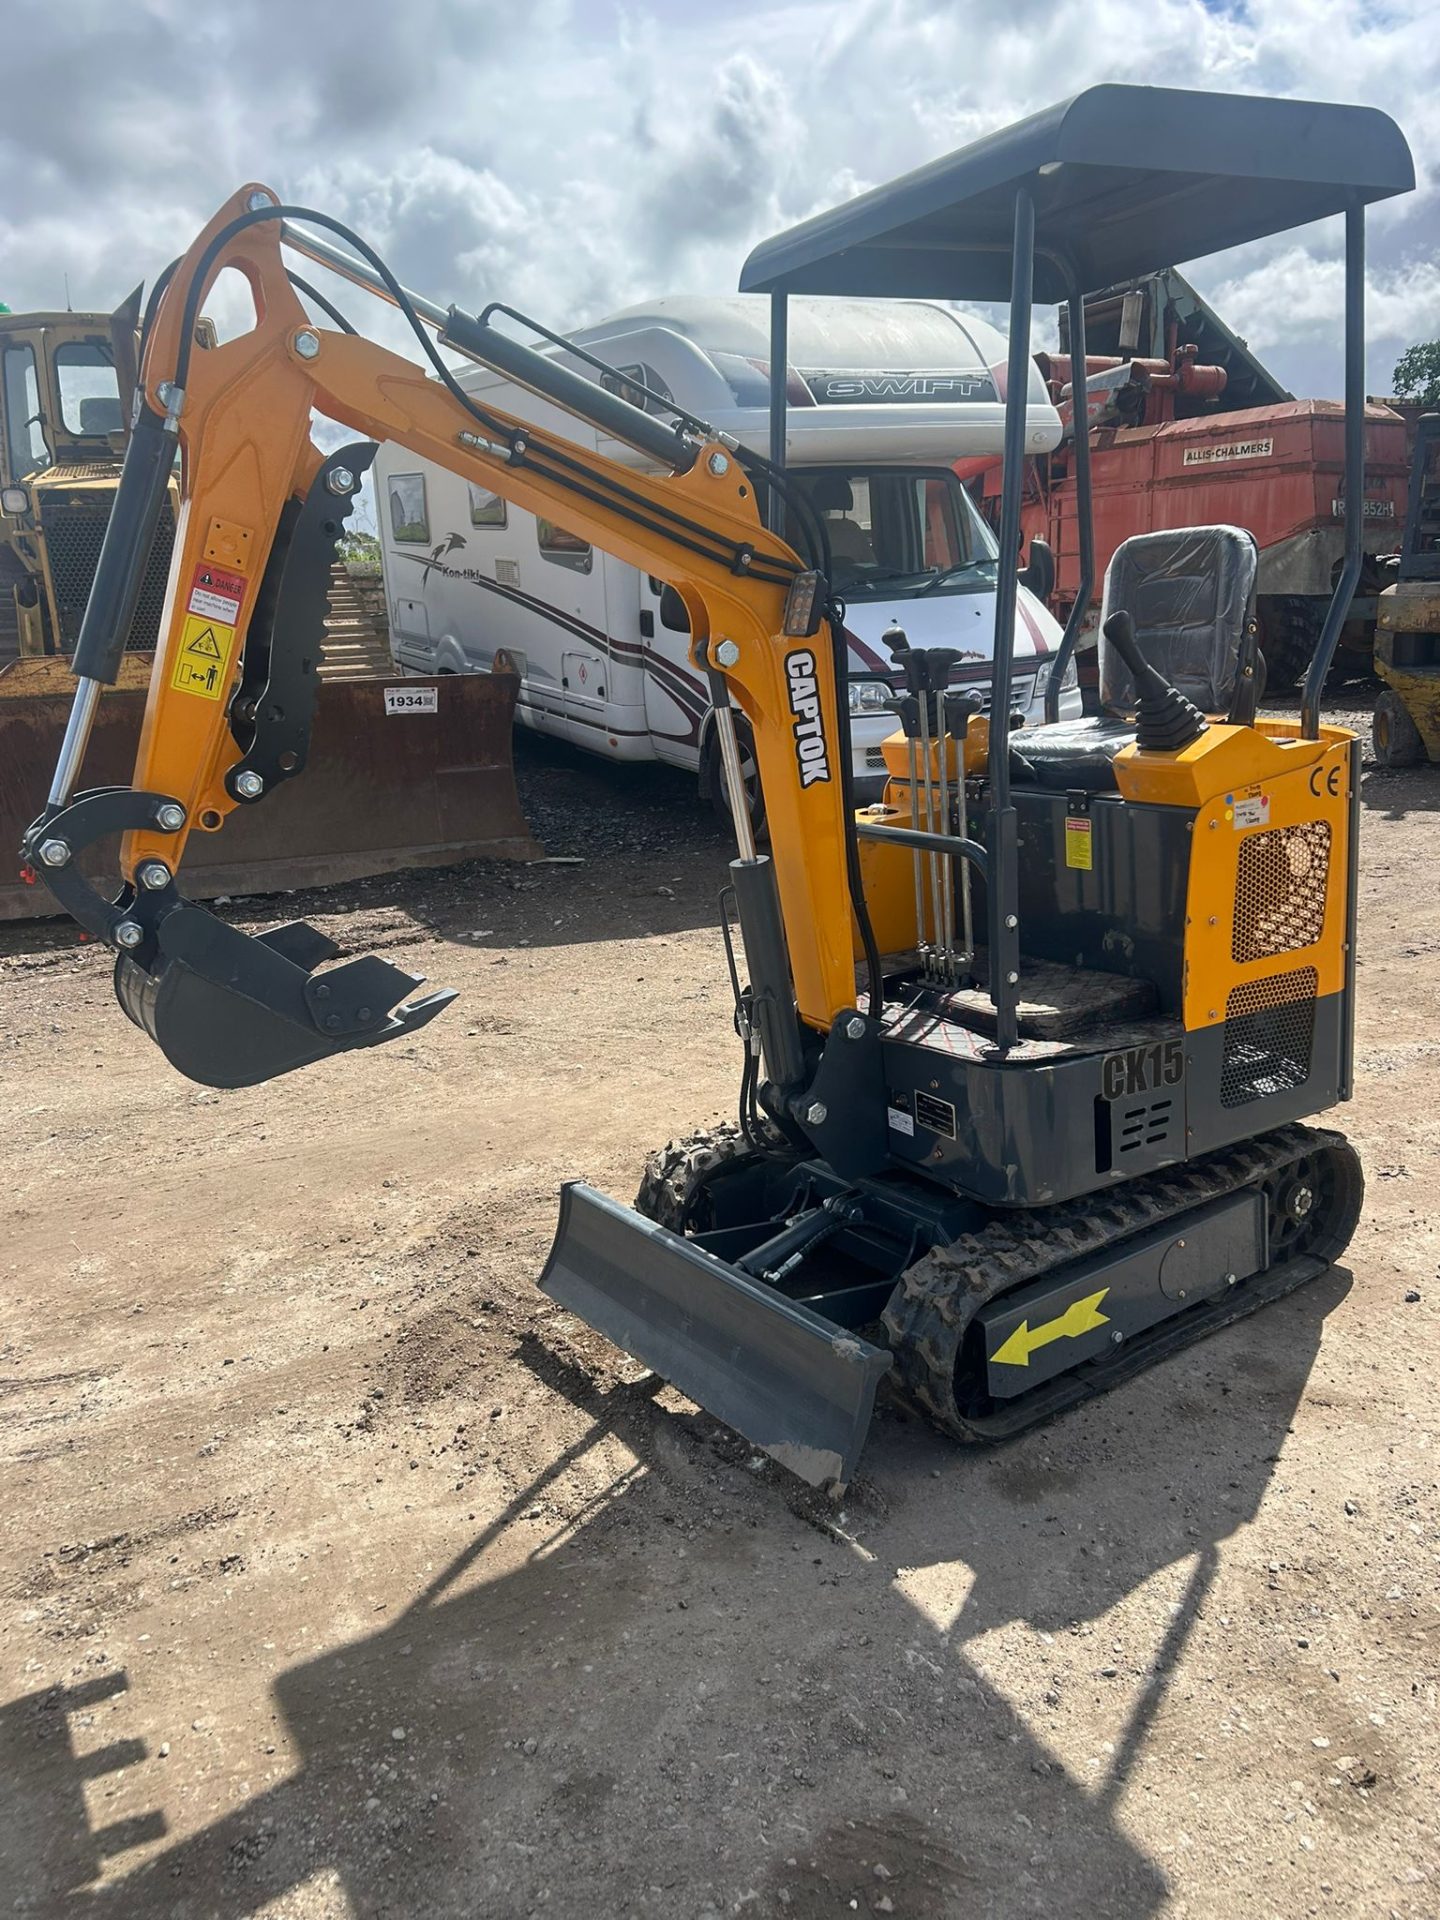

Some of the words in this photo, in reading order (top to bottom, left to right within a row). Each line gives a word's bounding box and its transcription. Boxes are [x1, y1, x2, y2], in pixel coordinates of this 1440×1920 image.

[826, 378, 982, 398] SWIFT
[1186, 442, 1271, 462] ALLIS-CHALMERS
[442, 566, 480, 580] Kon-tiki
[216, 579, 242, 594] DANGER
[388, 695, 423, 707] 1934
[785, 649, 831, 788] CAPTOK
[1309, 766, 1341, 797] CE
[1101, 1038, 1185, 1101] CK15
